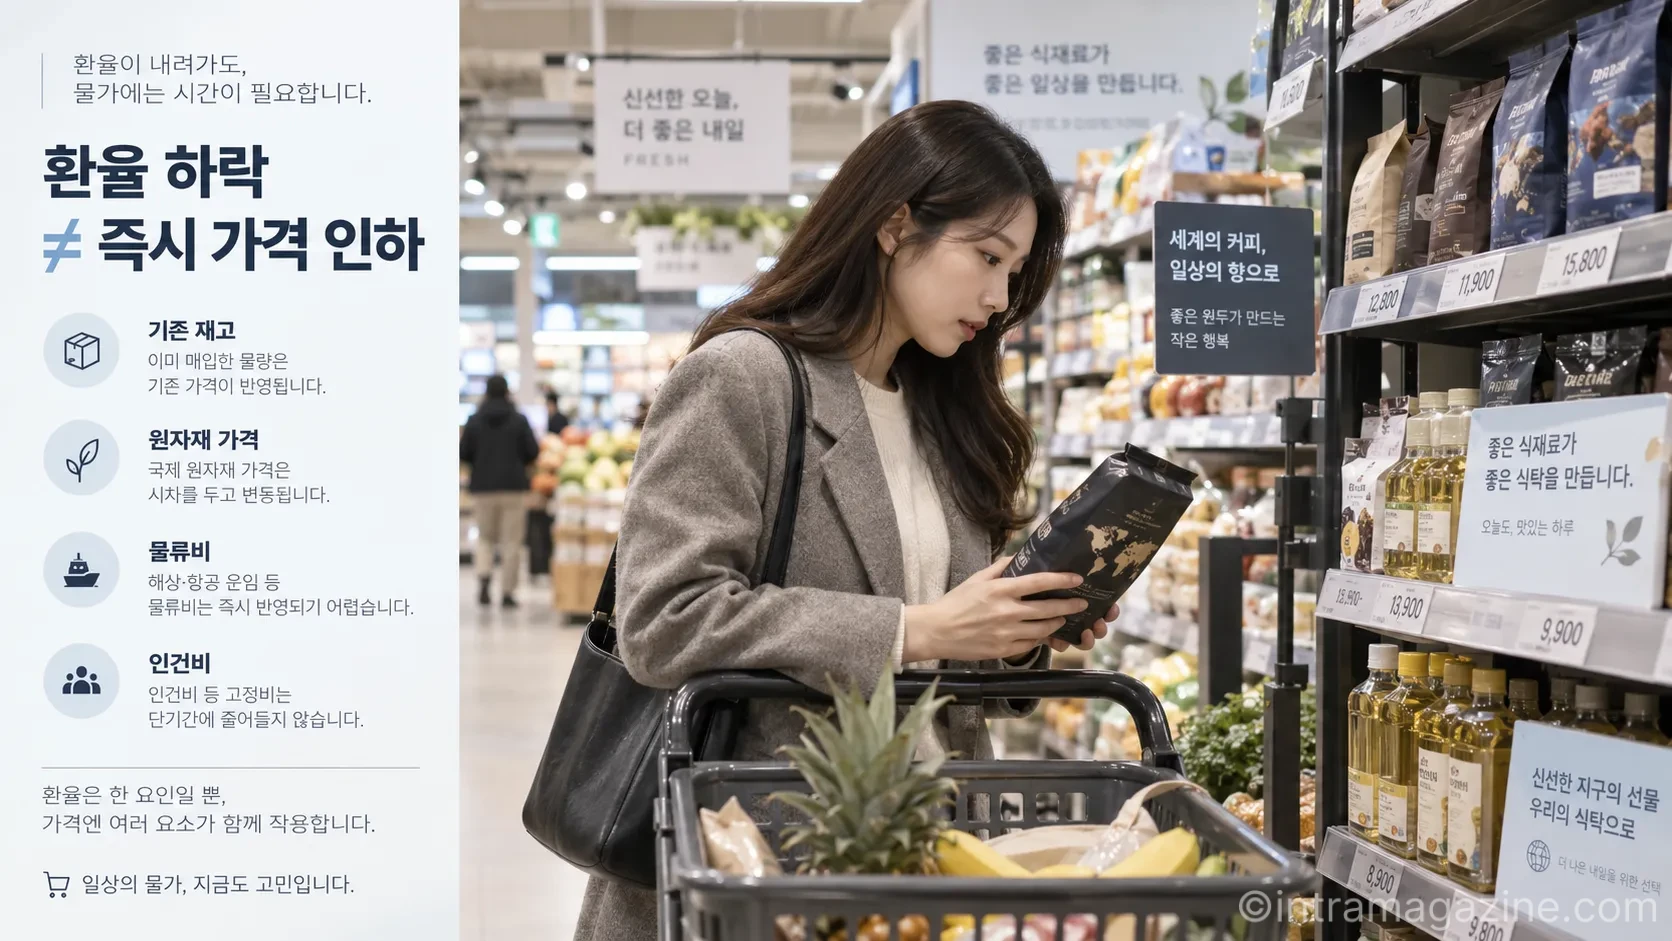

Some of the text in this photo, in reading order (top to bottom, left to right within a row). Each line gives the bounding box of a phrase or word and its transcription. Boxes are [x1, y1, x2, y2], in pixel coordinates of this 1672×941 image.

[984, 44, 1110, 66] 좋은 식재료가
[984, 73, 1184, 95] 좋은 일상을 만듭니다.
[623, 87, 740, 111] 신선한 오늘,
[623, 118, 745, 142] 더 좋은 내일
[623, 153, 689, 167] FRESH
[1169, 229, 1266, 256] 세계의 커피,
[1170, 259, 1281, 283] 일상의 향으로
[1562, 246, 1607, 277] 15,800
[1458, 268, 1495, 297] 11,900
[1367, 289, 1399, 314] 12,800
[1170, 307, 1286, 327] 좋은 원두가 만드는
[1170, 332, 1230, 350] 작은 행복
[1488, 431, 1578, 460] 좋은 식재료가
[1485, 463, 1634, 491] 좋은 식탁을 만듭니다.
[1481, 518, 1576, 537] 오늘도, 맛있는 하루
[1389, 594, 1425, 621] 13,900
[1540, 617, 1585, 647] 9,900
[1532, 767, 1661, 814] 신선한 지구의 선물
[1529, 797, 1636, 841] 우리의 식탁으로
[1366, 864, 1395, 894] 8,900
[1558, 856, 1662, 897] 더 나은 내일을 위한 선택
